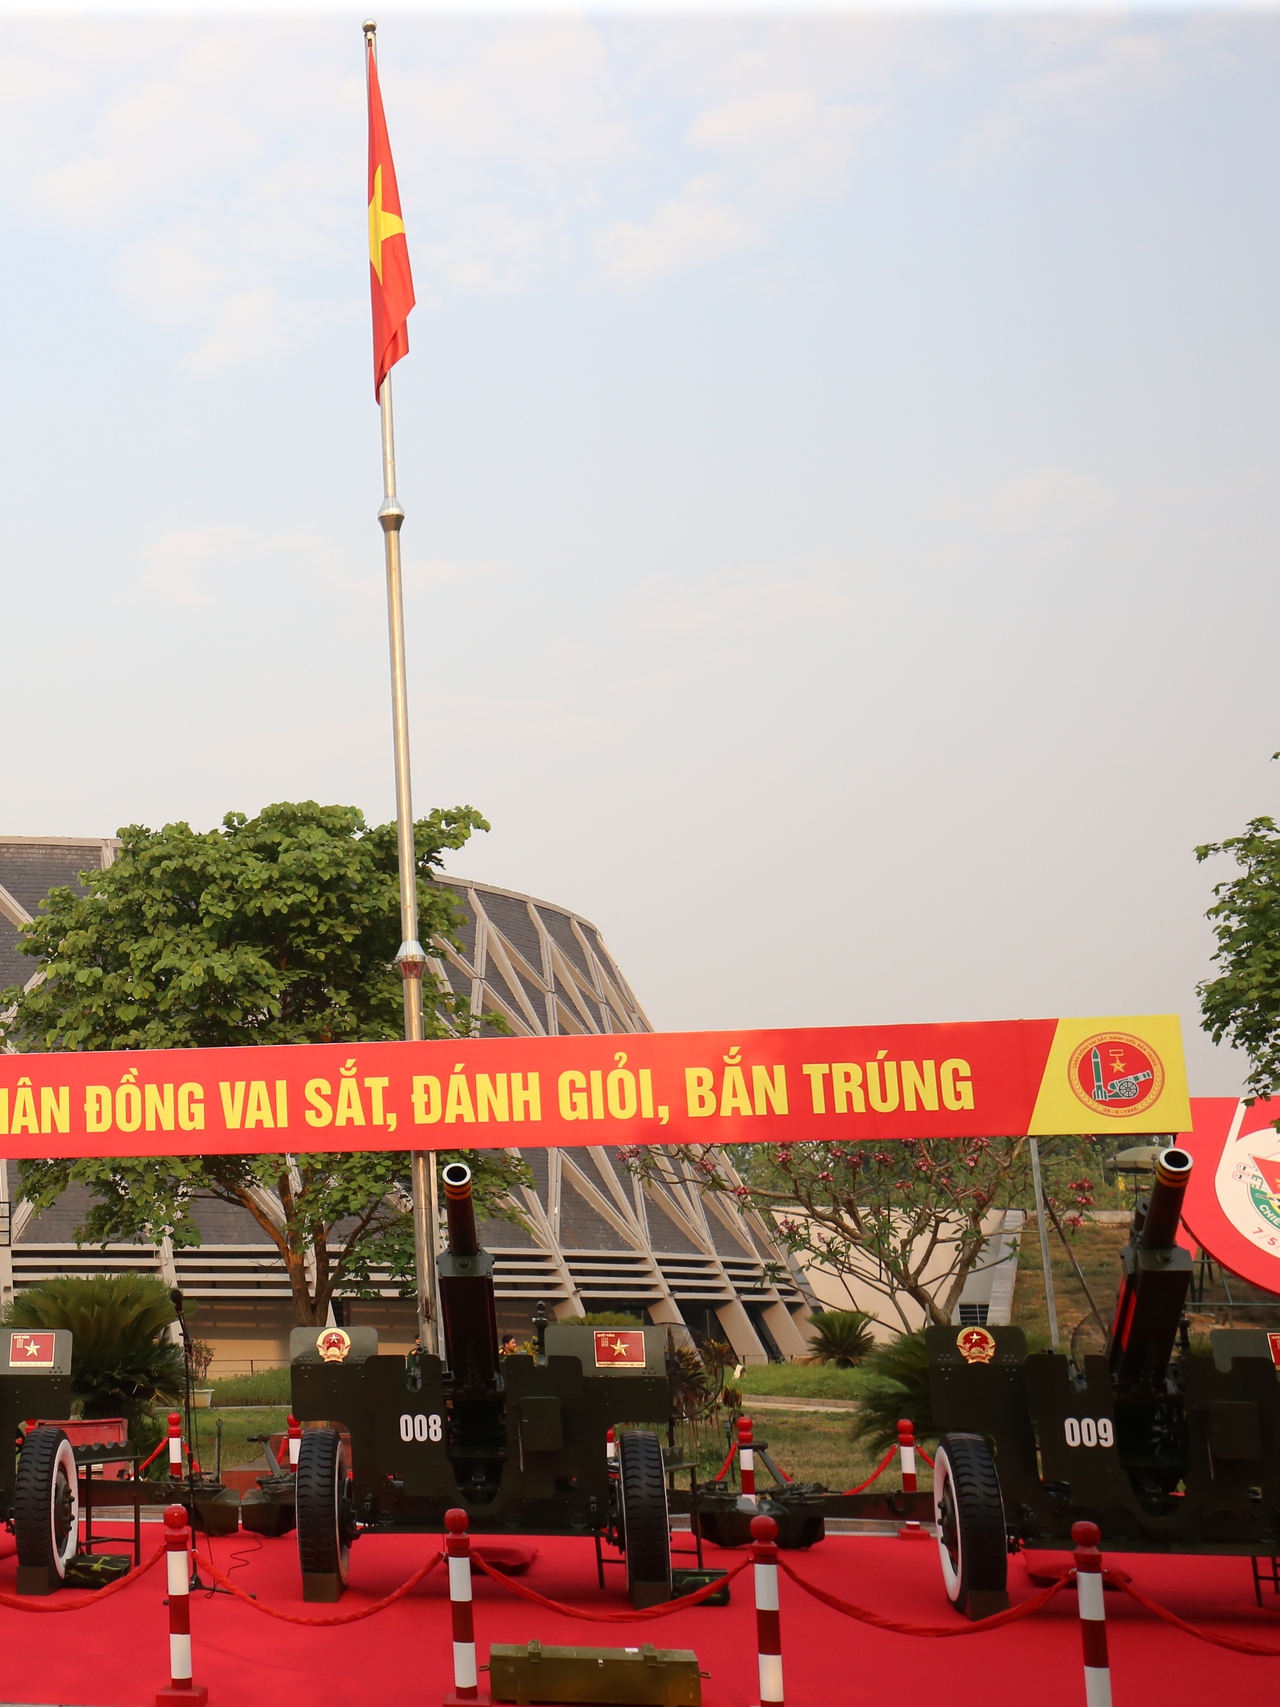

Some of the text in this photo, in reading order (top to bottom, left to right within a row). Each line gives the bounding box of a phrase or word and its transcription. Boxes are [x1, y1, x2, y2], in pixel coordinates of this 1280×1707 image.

[83, 1067, 205, 1133] ĐỒNG
[218, 1079, 289, 1130] VAI
[304, 1058, 397, 1132] SẮT,
[410, 1063, 542, 1125] ĐÁNH
[557, 1051, 670, 1125] GIỎI,
[684, 1046, 789, 1118] BẮN
[802, 1049, 975, 1114] TRÚNG
[400, 1414, 443, 1442] 008
[1064, 1417, 1114, 1448] 009
